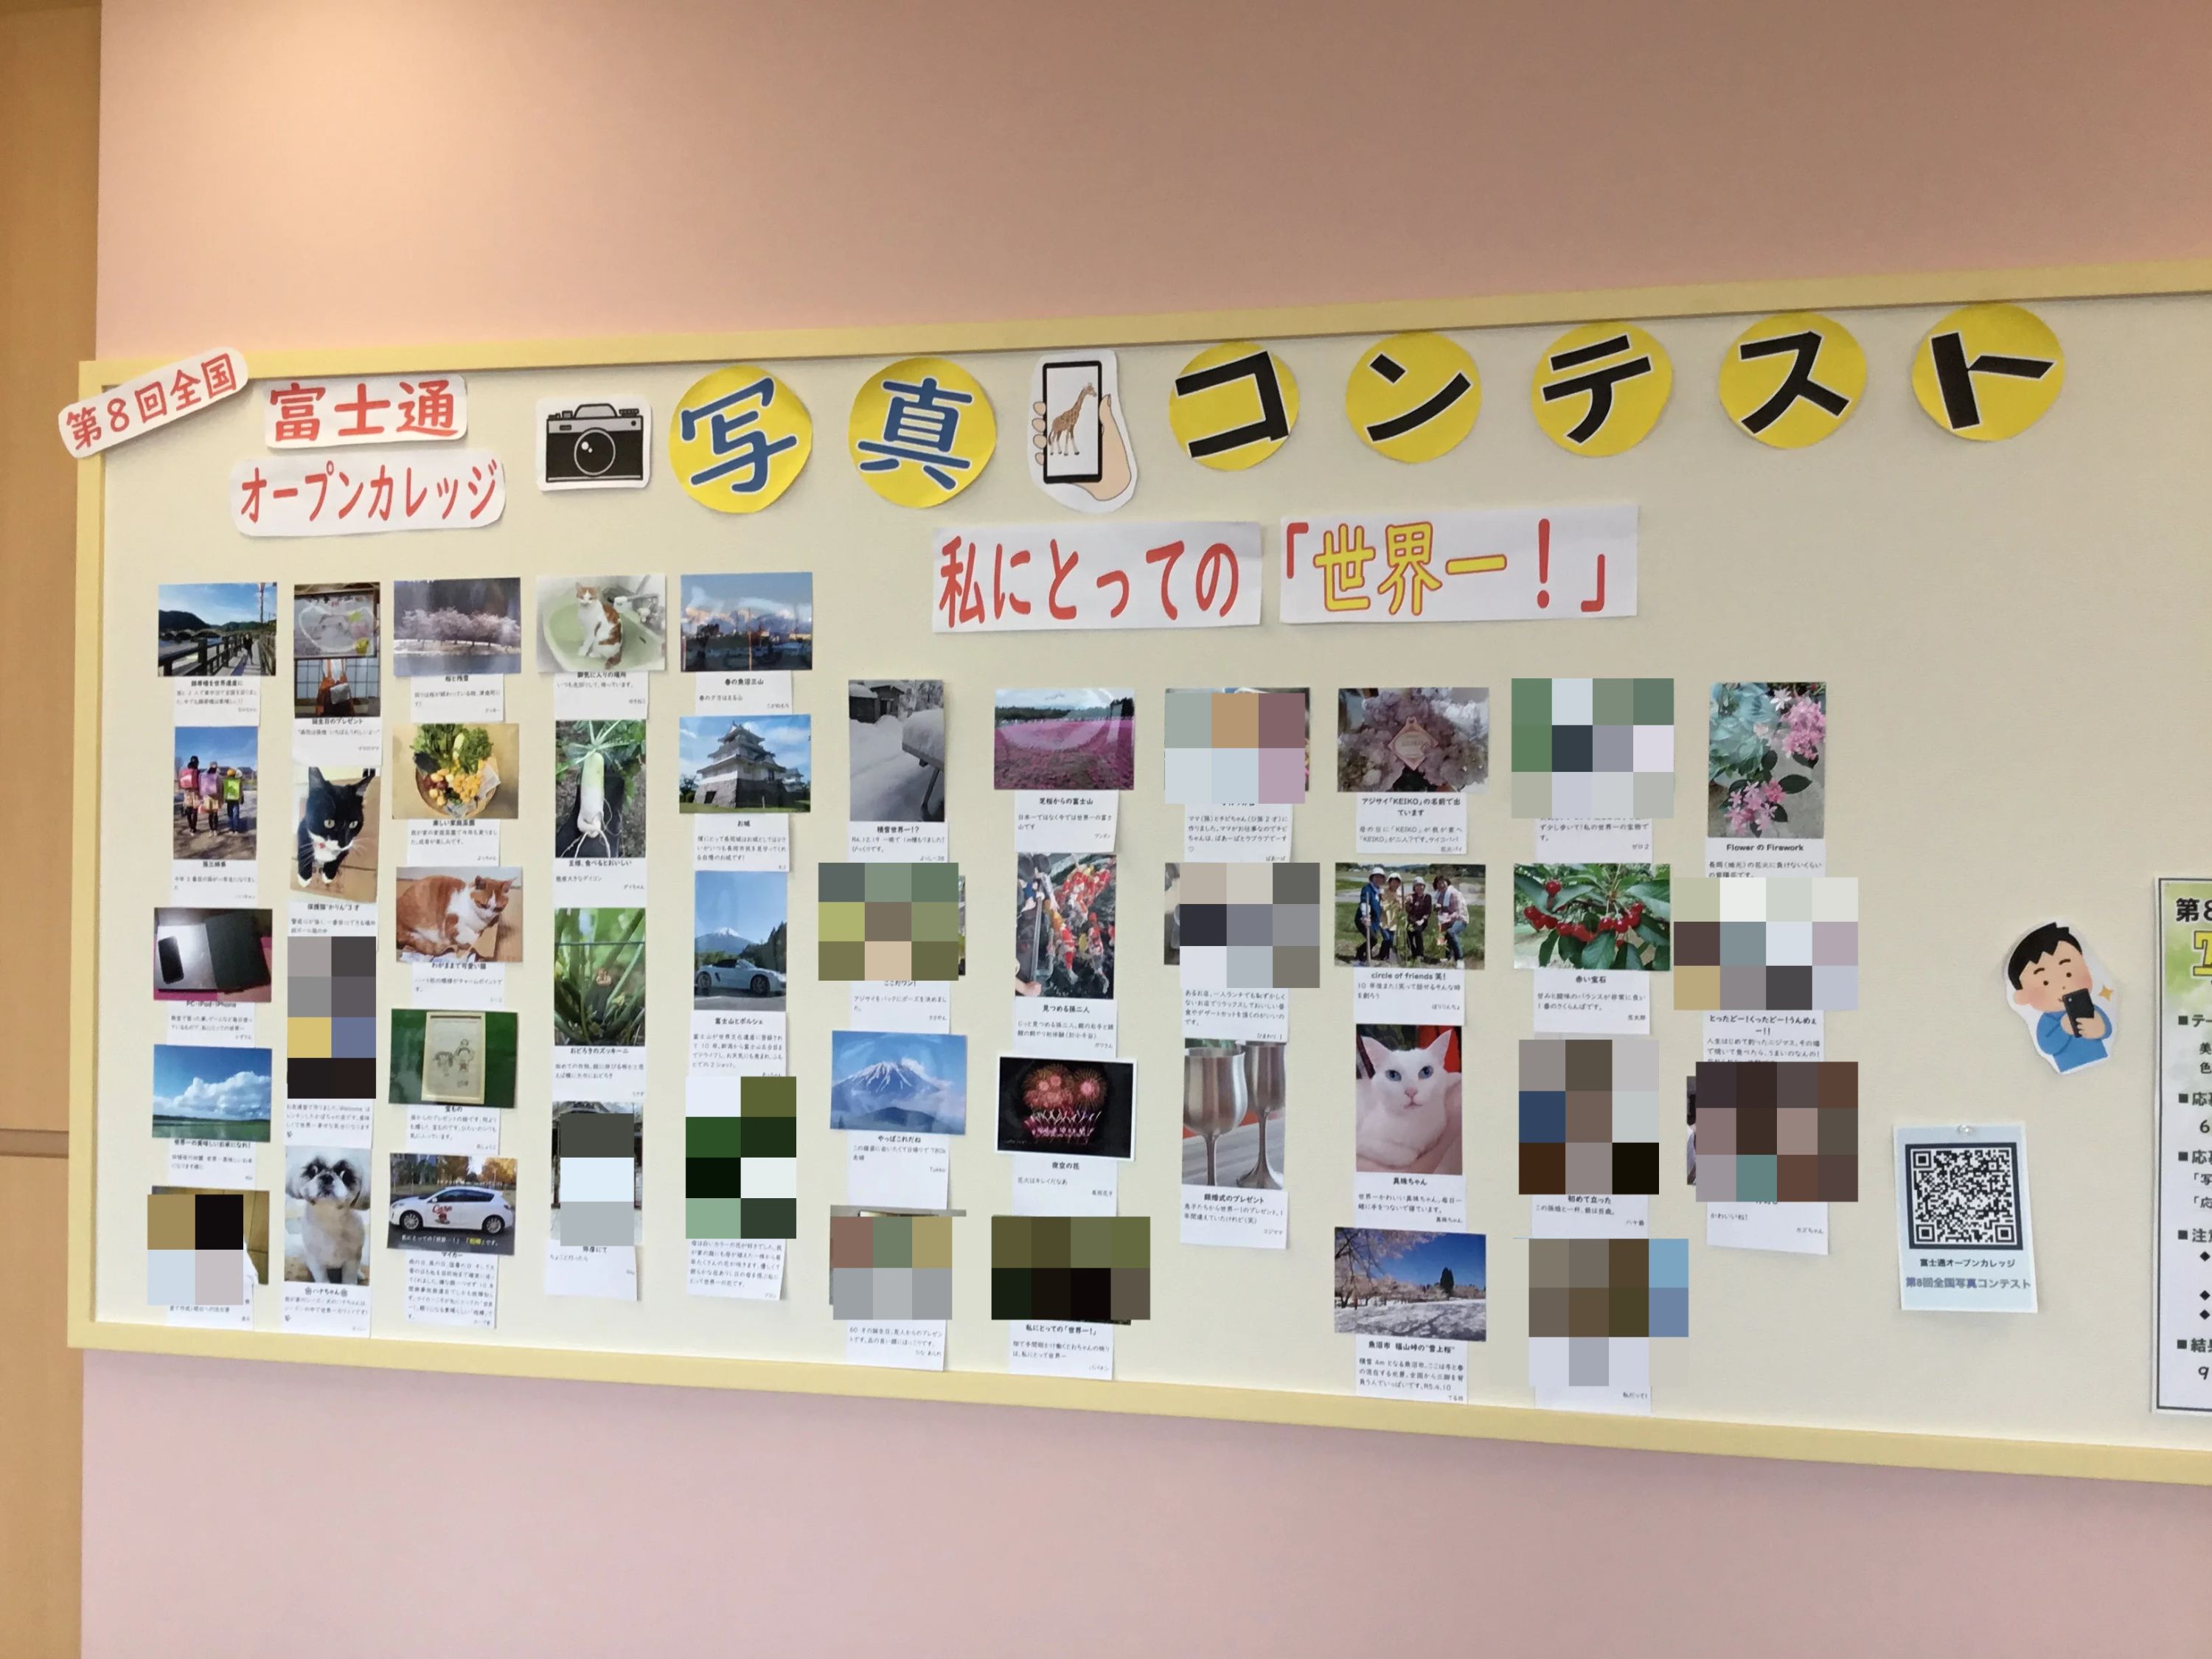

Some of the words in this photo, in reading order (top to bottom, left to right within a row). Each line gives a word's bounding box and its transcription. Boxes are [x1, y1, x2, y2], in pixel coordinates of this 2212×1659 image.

[66, 352, 237, 451] 第8回全国
[269, 379, 460, 442] 富士通
[240, 459, 499, 523] オープンカレッジ
[939, 535, 1239, 628] 私にとっての
[1576, 975, 1607, 984] 赤い宝石
[1043, 1005, 1090, 1013] 見つめる孫二人
[1186, 1009, 1284, 1019] 食やデザートセットを頂くのがいいの
[1708, 1038, 1820, 1047] 人生はじめて釣ったニジマス。その場
[2192, 1091, 2212, 1107] 応
[2199, 1119, 2211, 1133] 6
[2192, 1150, 2212, 1165] 応
[1204, 1193, 1264, 1204] 銀婚式のプレゼント
[1568, 1195, 1611, 1204] 初めて立った
[2192, 1228, 2212, 1243] 注
[1920, 1259, 2015, 1267] 富士通オープンカレッジ
[1906, 1277, 2031, 1289] 第8回全国写真コンテスト
[1368, 1340, 1391, 1349] 魚沼市
[2191, 1338, 2212, 1354] 結
[2198, 1366, 2209, 1380] 9
